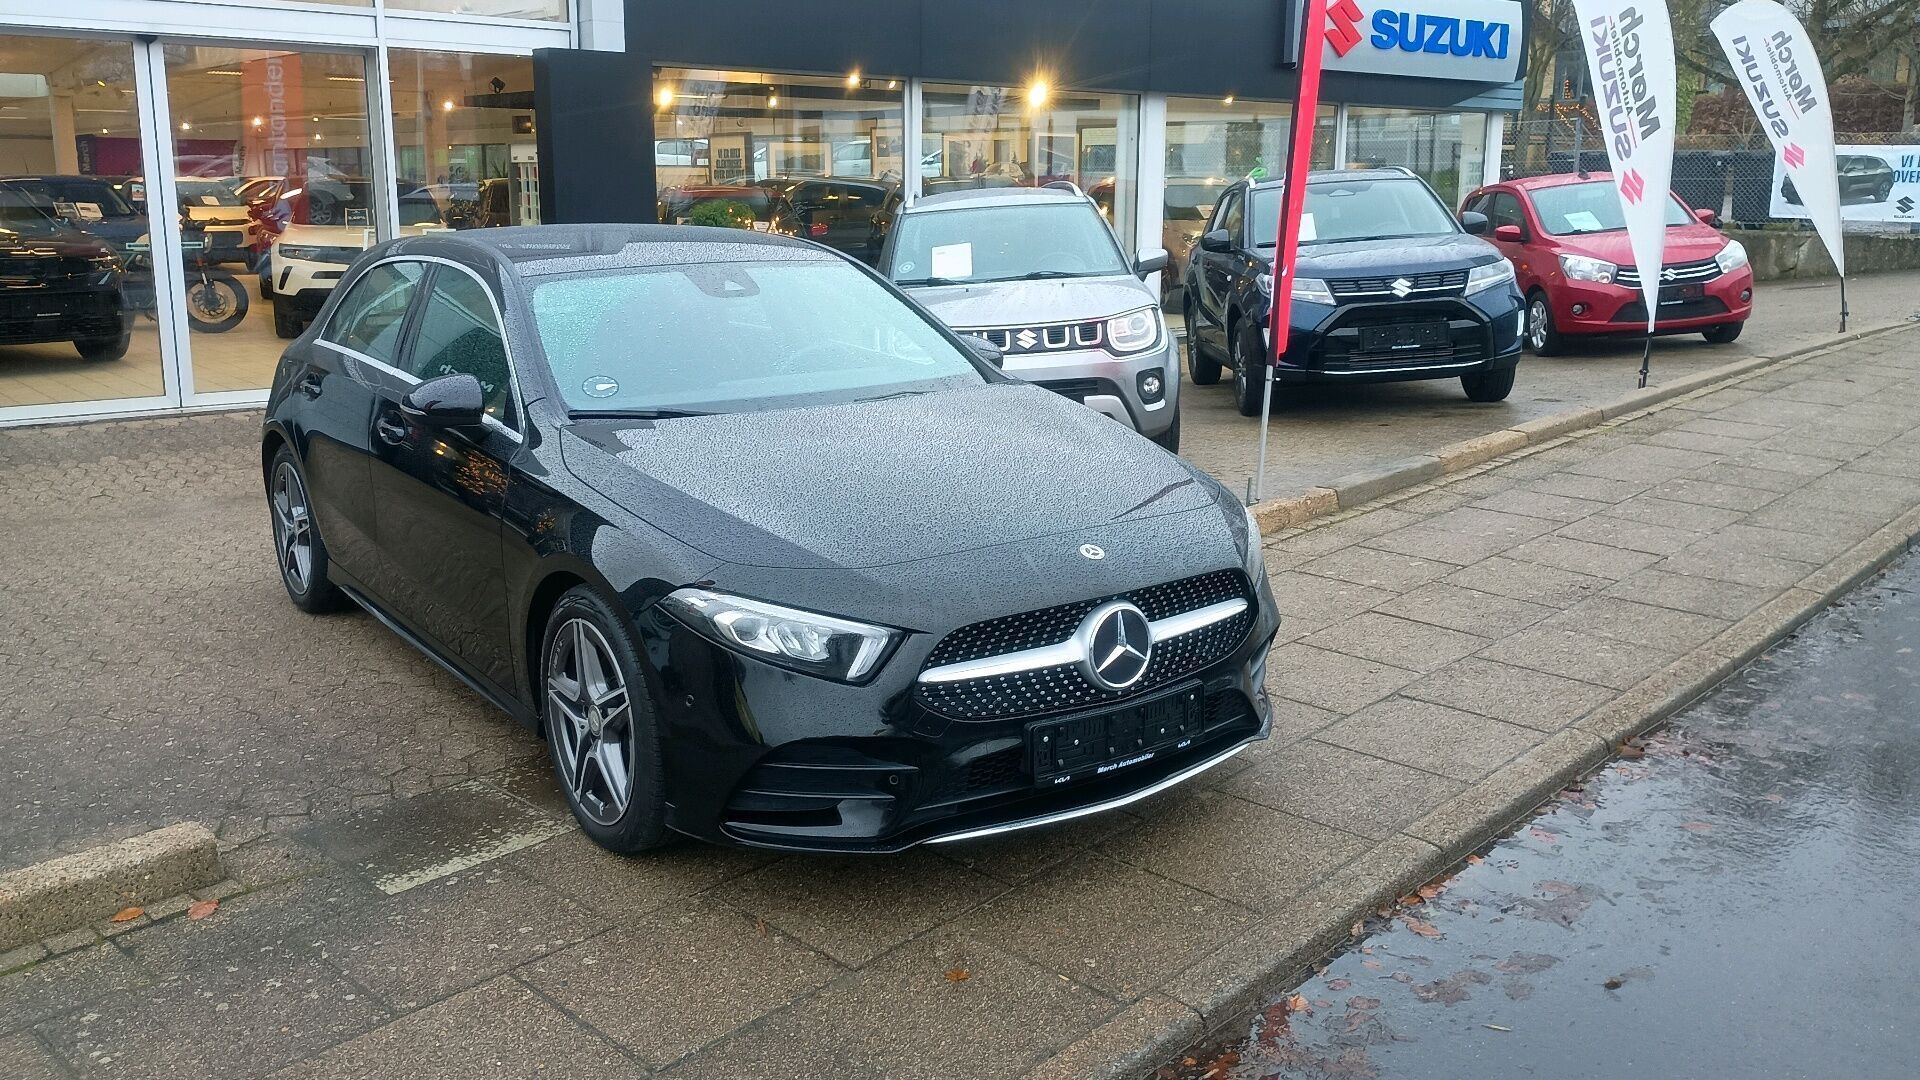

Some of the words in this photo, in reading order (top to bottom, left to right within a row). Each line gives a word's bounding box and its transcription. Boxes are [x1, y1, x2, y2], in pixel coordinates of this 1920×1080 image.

[1370, 9, 1510, 60] SUZUKI
[264, 57, 288, 178] antander
[1901, 155, 1914, 168] VI
[1118, 753, 1155, 768] Automobiler
